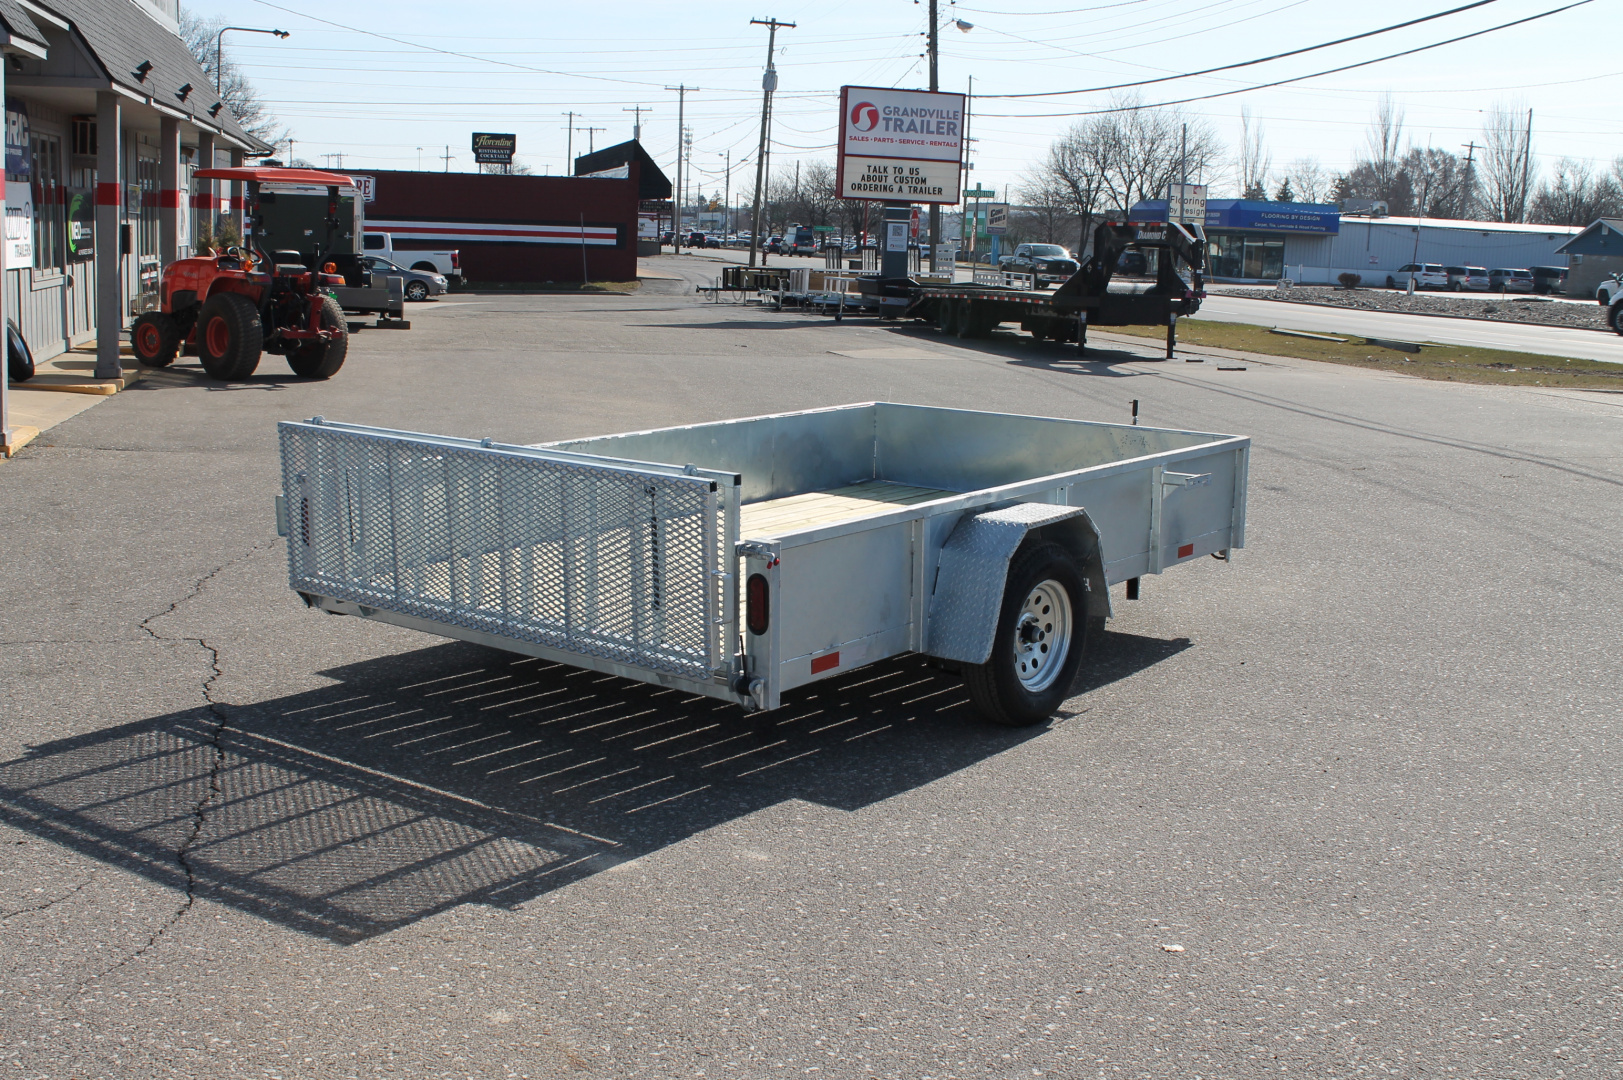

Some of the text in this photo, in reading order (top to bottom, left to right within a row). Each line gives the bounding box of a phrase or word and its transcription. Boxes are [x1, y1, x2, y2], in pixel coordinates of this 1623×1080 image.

[882, 105, 959, 120] GRANDVILLE
[882, 117, 958, 136] TRAILER
[474, 135, 513, 148] Florentine
[866, 165, 920, 175] TALK TO US
[860, 174, 927, 185] ABOUT CUSTOM
[850, 182, 943, 195] ORDERING A TRAILER
[963, 190, 994, 198] WOODBINE
[1170, 195, 1205, 207] Flooring
[1170, 207, 1178, 215] by
[1181, 208, 1205, 216] esign
[1261, 212, 1290, 220] FLOORING
[1137, 230, 1162, 240] DIAMOND
